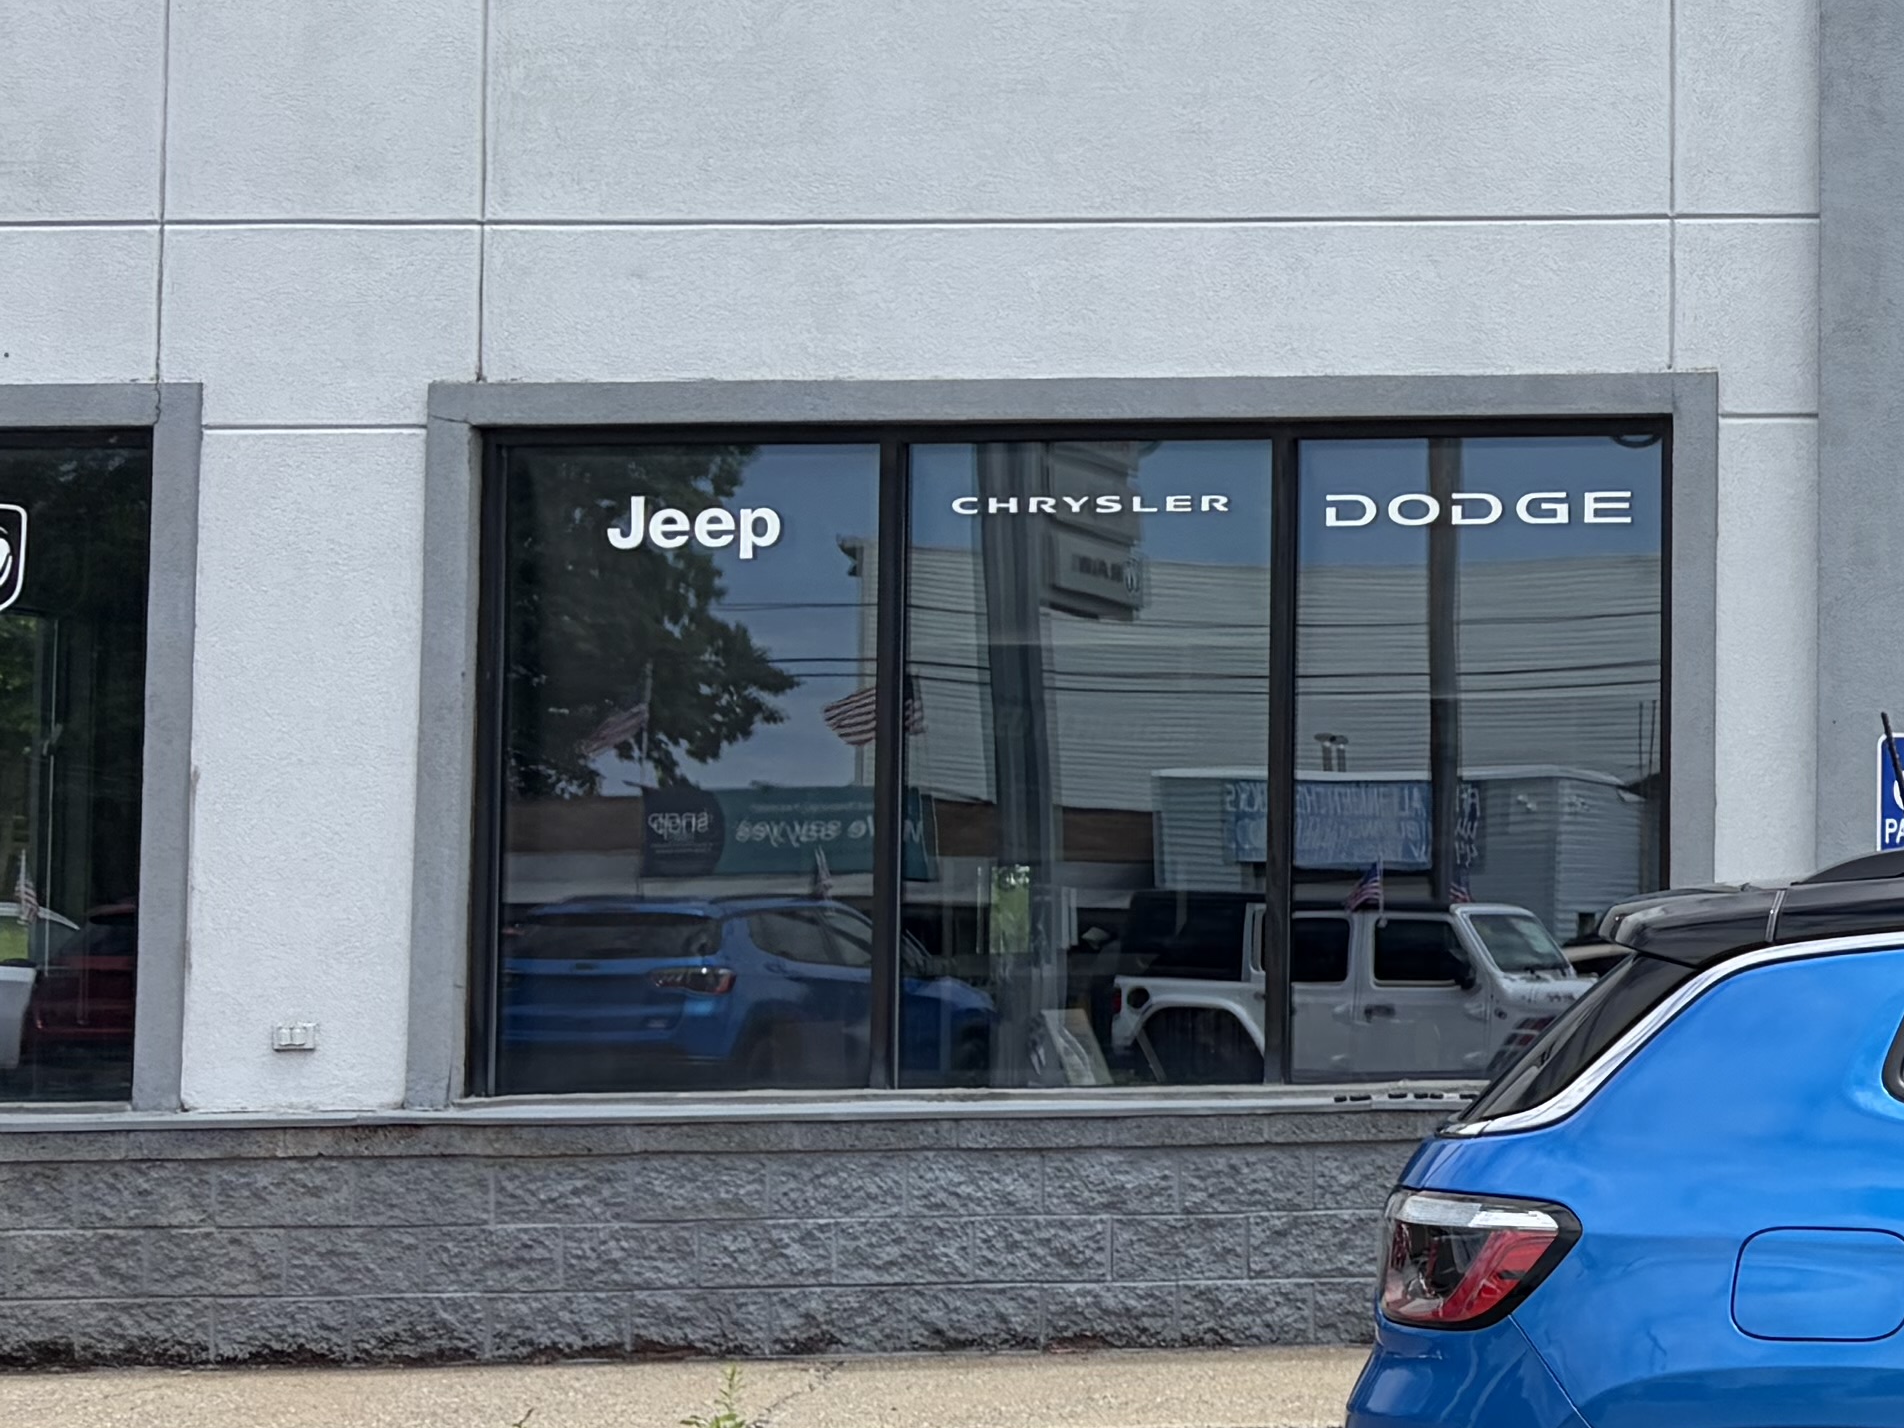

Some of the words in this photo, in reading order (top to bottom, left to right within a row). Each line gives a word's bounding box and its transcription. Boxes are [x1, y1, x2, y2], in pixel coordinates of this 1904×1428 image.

[951, 494, 1231, 515] CHRYSLER
[1325, 490, 1633, 528] DODGE
[606, 496, 782, 559] Jeep
